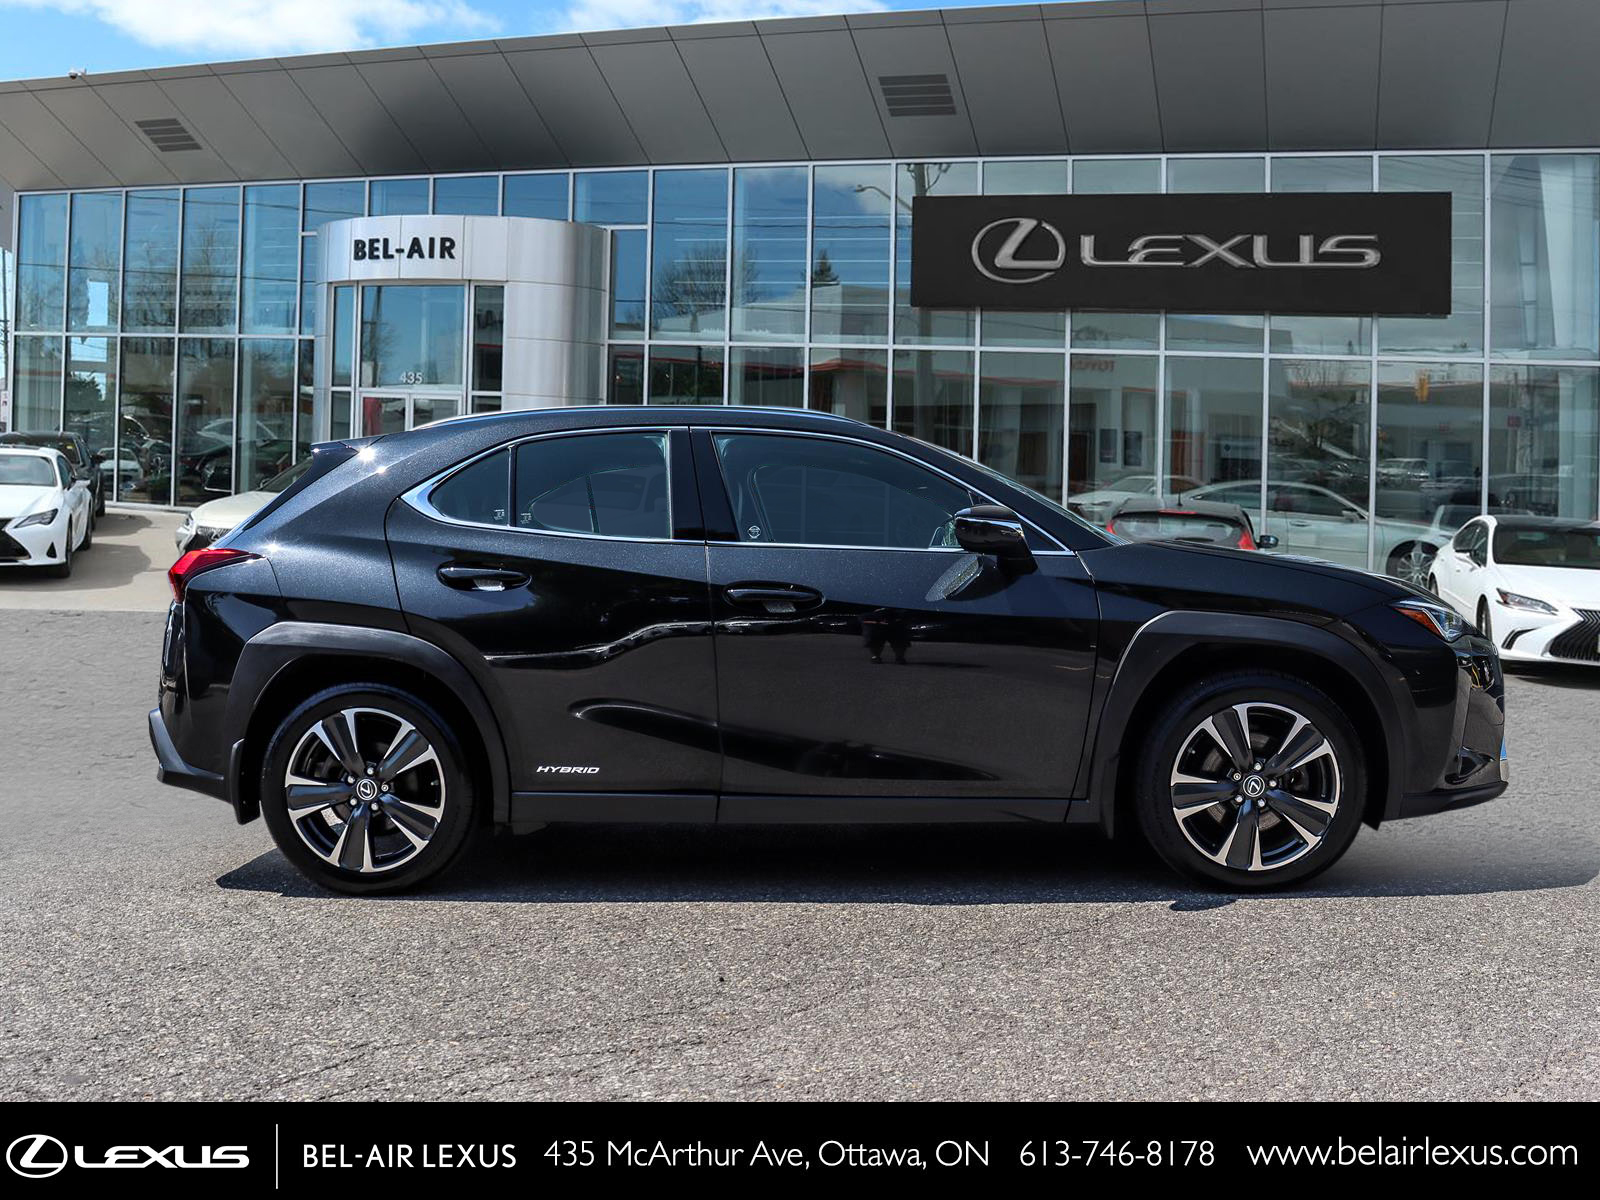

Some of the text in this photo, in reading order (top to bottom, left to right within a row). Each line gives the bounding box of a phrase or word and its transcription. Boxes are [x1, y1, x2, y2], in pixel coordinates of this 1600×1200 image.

[353, 236, 456, 261] BEL-AIR
[1080, 234, 1381, 268] LEXUS
[400, 371, 423, 384] 435
[536, 765, 600, 774] HYBRID
